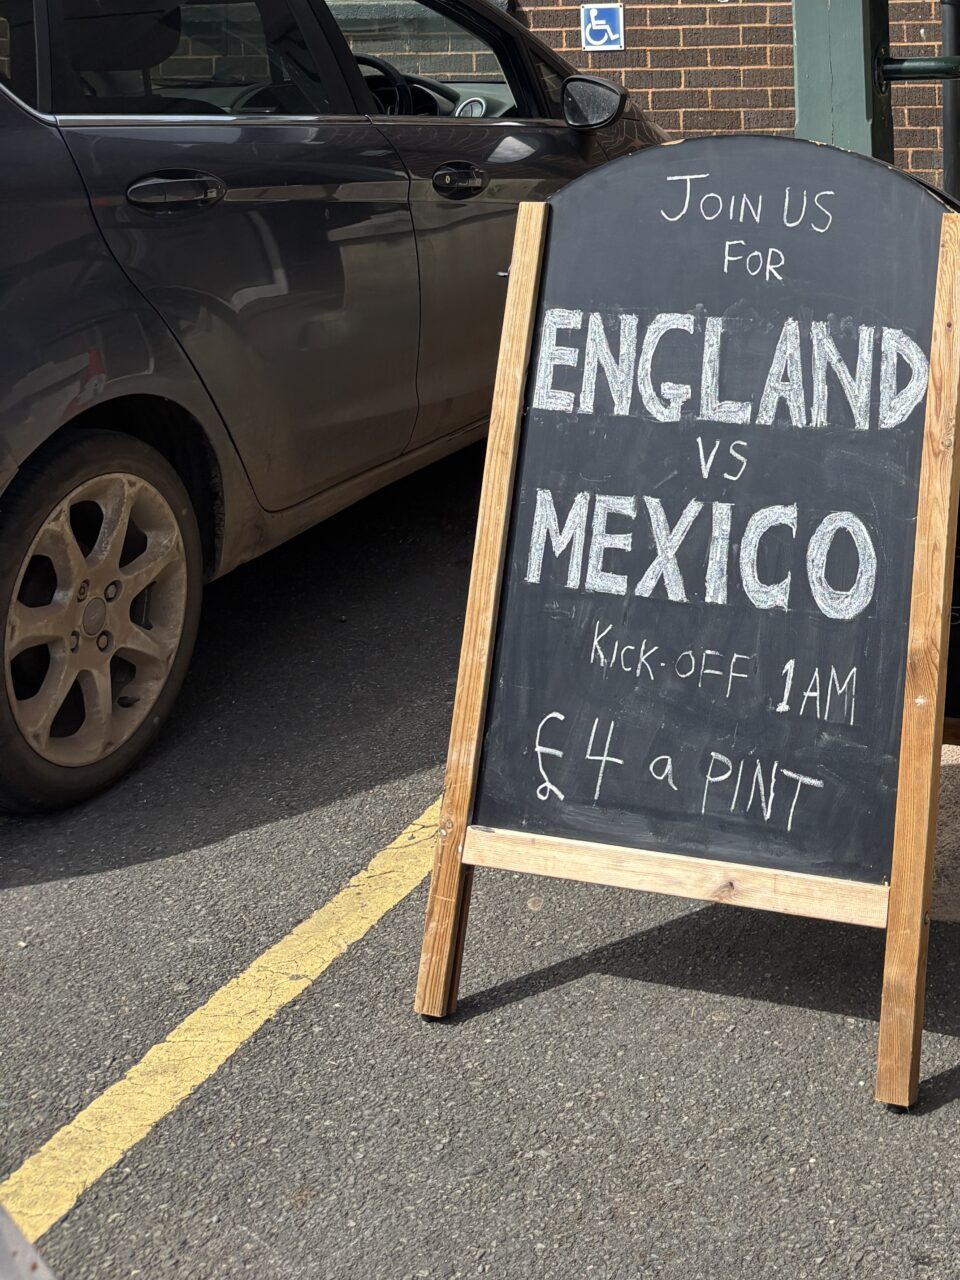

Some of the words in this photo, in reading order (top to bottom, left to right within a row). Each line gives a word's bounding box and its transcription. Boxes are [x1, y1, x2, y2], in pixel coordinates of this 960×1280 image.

[660, 173, 763, 224] JOIN
[783, 186, 836, 233] US
[723, 239, 785, 282] FOR
[531, 308, 930, 430] ENGLAND
[696, 435, 749, 481] VS
[523, 487, 878, 620] MEXICO
[775, 658, 857, 726] 1AM
[649, 755, 678, 791] a
[700, 751, 824, 832] PINT
